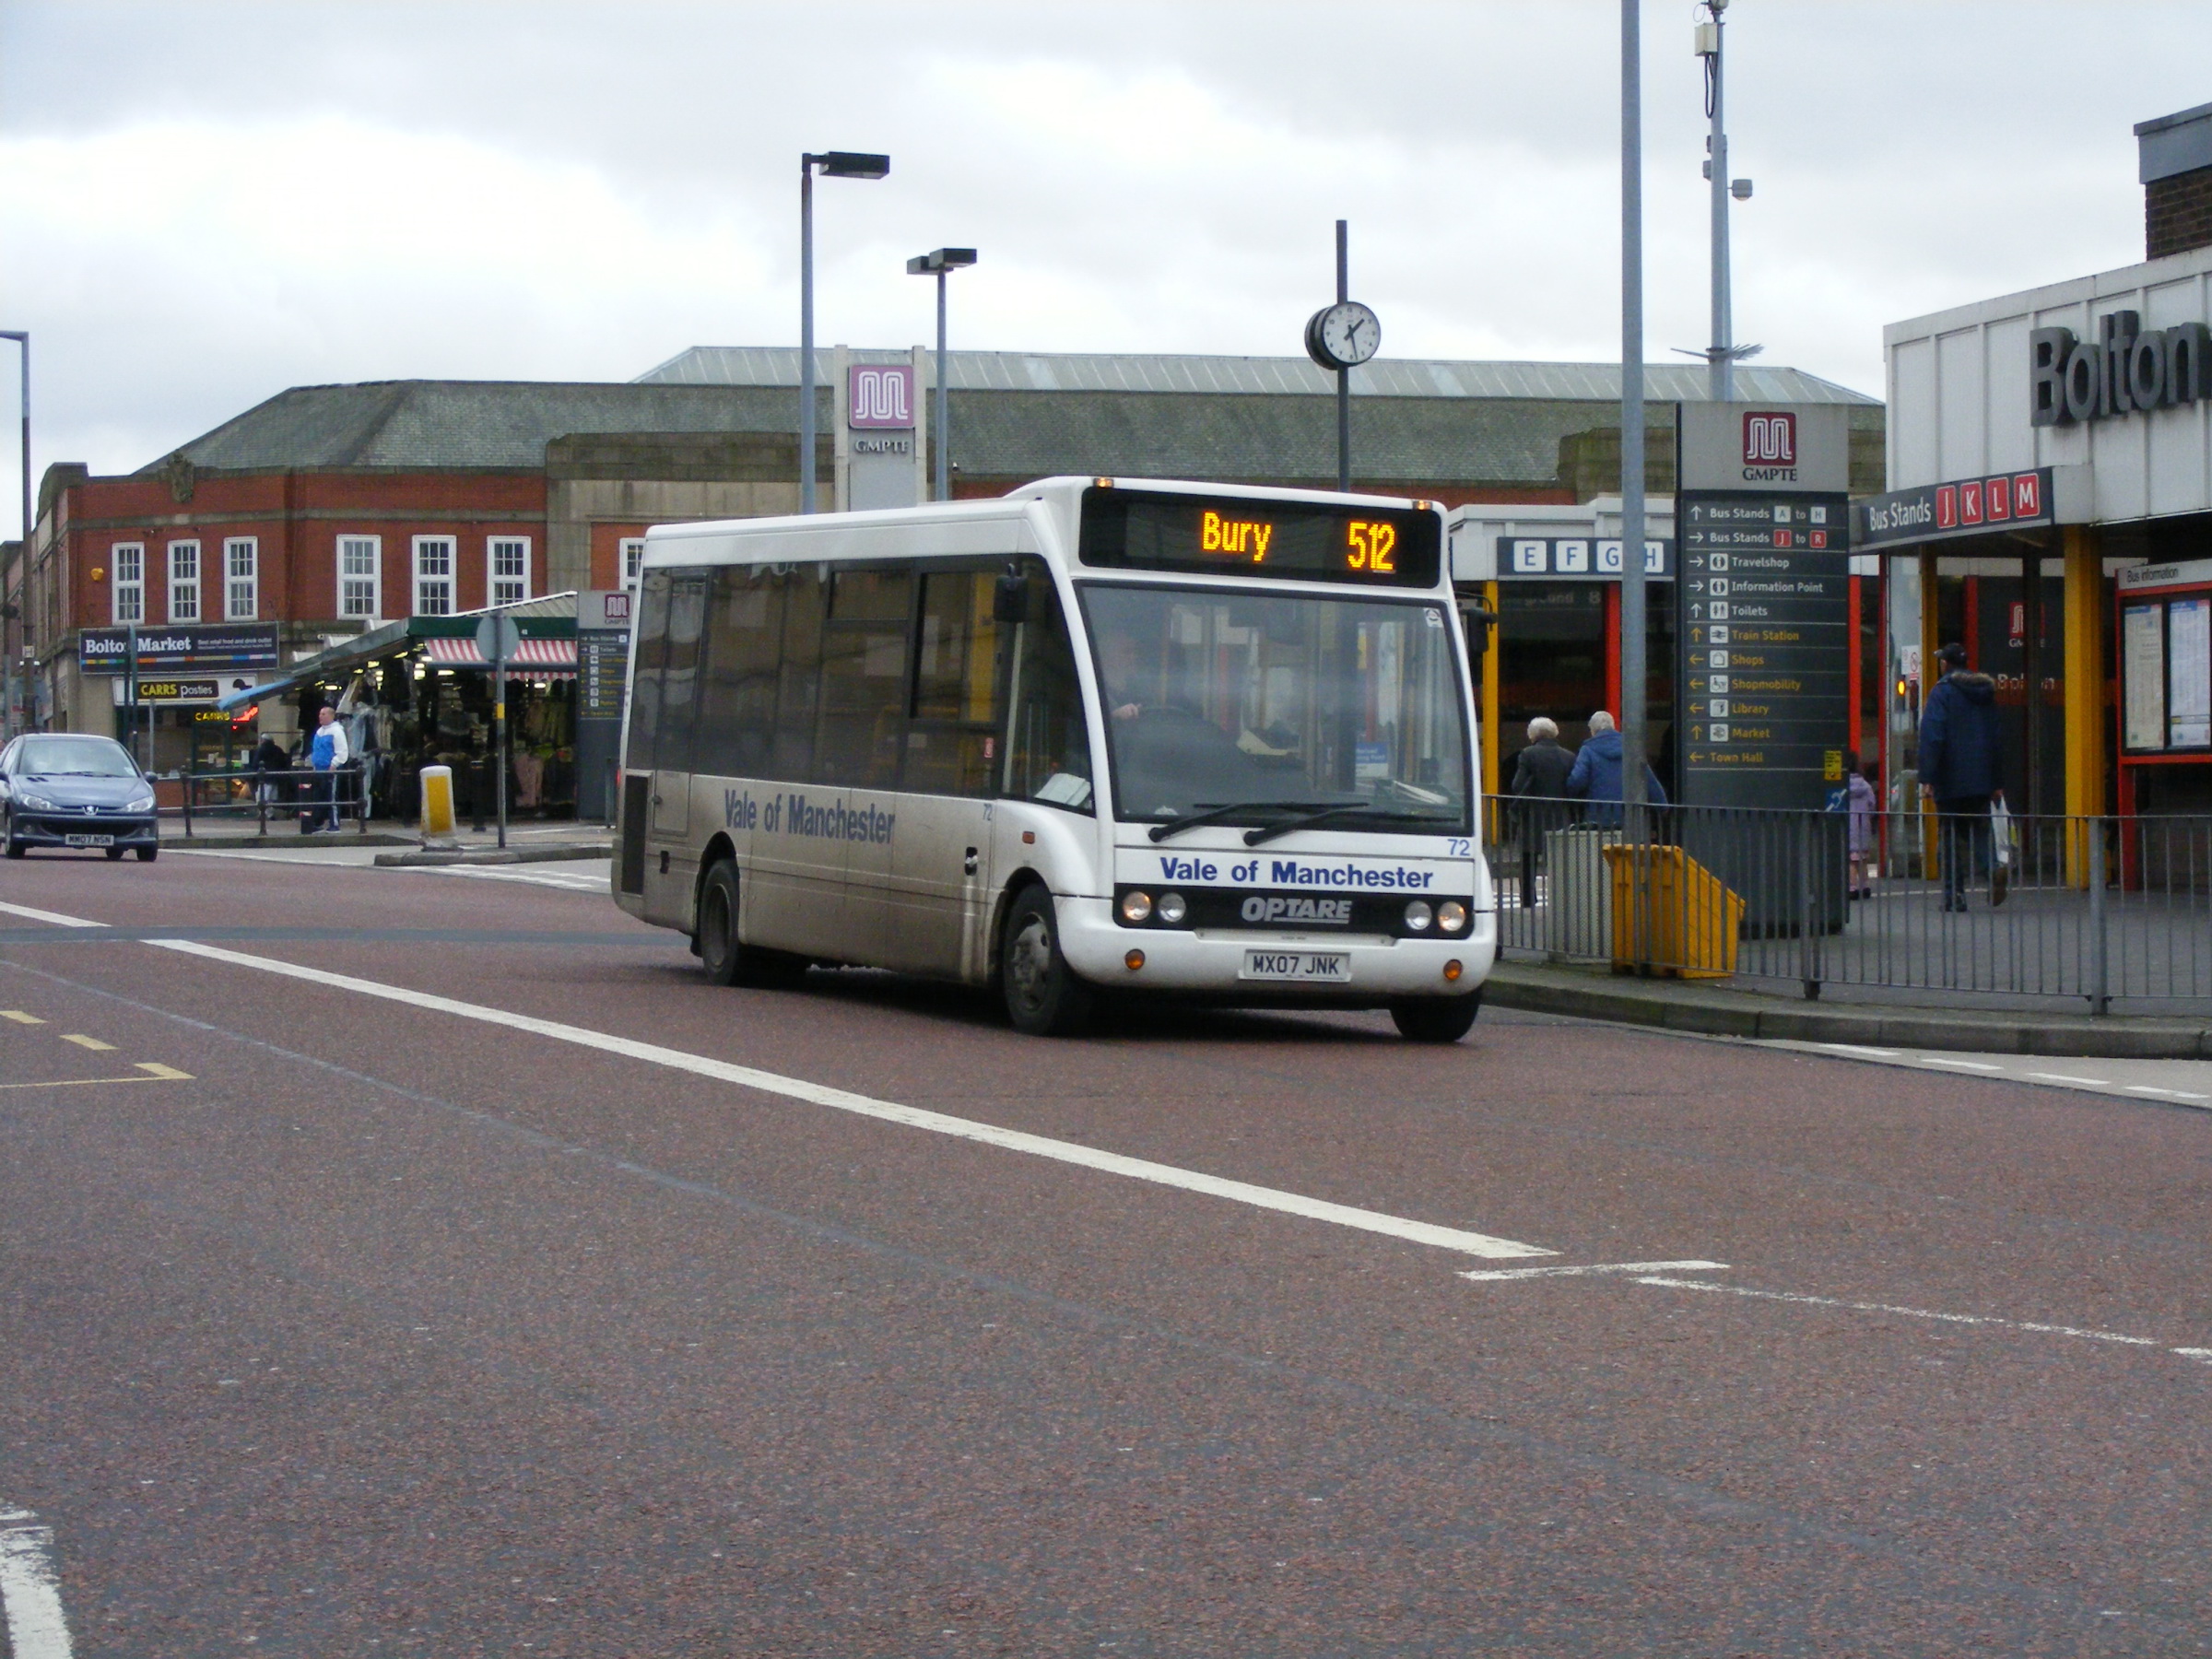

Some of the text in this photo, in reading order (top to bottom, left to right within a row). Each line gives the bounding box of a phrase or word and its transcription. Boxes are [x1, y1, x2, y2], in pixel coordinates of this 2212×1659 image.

[2030, 310, 2210, 428] Bolton
[854, 440, 909, 453] GMPTE
[1742, 467, 1797, 481] GMPTE
[1710, 508, 1822, 519] Bus Stands A to H
[1869, 482, 2035, 531] Bus Stands J K L M
[1202, 512, 1396, 571] Bury 512
[1710, 532, 1730, 542] Bus
[1733, 533, 1770, 543] Stands
[1795, 535, 1806, 544] to
[1815, 535, 1822, 544] R
[1524, 547, 1656, 567] E F G H
[1732, 557, 1790, 569] Travelshop
[2126, 567, 2179, 582] Bus information
[1732, 581, 1823, 593] Information Point
[1731, 606, 1769, 617] Toilets
[1731, 629, 1800, 641] Train Station
[85, 639, 127, 653] Bolto
[137, 636, 192, 653] Market
[1731, 654, 1765, 665] Shops
[1731, 678, 1802, 691] Shopmobility
[1996, 672, 2055, 689] Boln
[141, 683, 213, 699] CARRS pasties
[1732, 703, 1770, 715] Library
[1732, 728, 1771, 738] Market
[1710, 752, 1763, 762] Town Hall
[724, 789, 896, 844] Vale of Manchester
[1447, 839, 1470, 856] 72
[1160, 857, 1434, 888] Vale of Manchester
[1241, 896, 1353, 924] OPTARE
[1253, 956, 1339, 975] MX07 JNK
